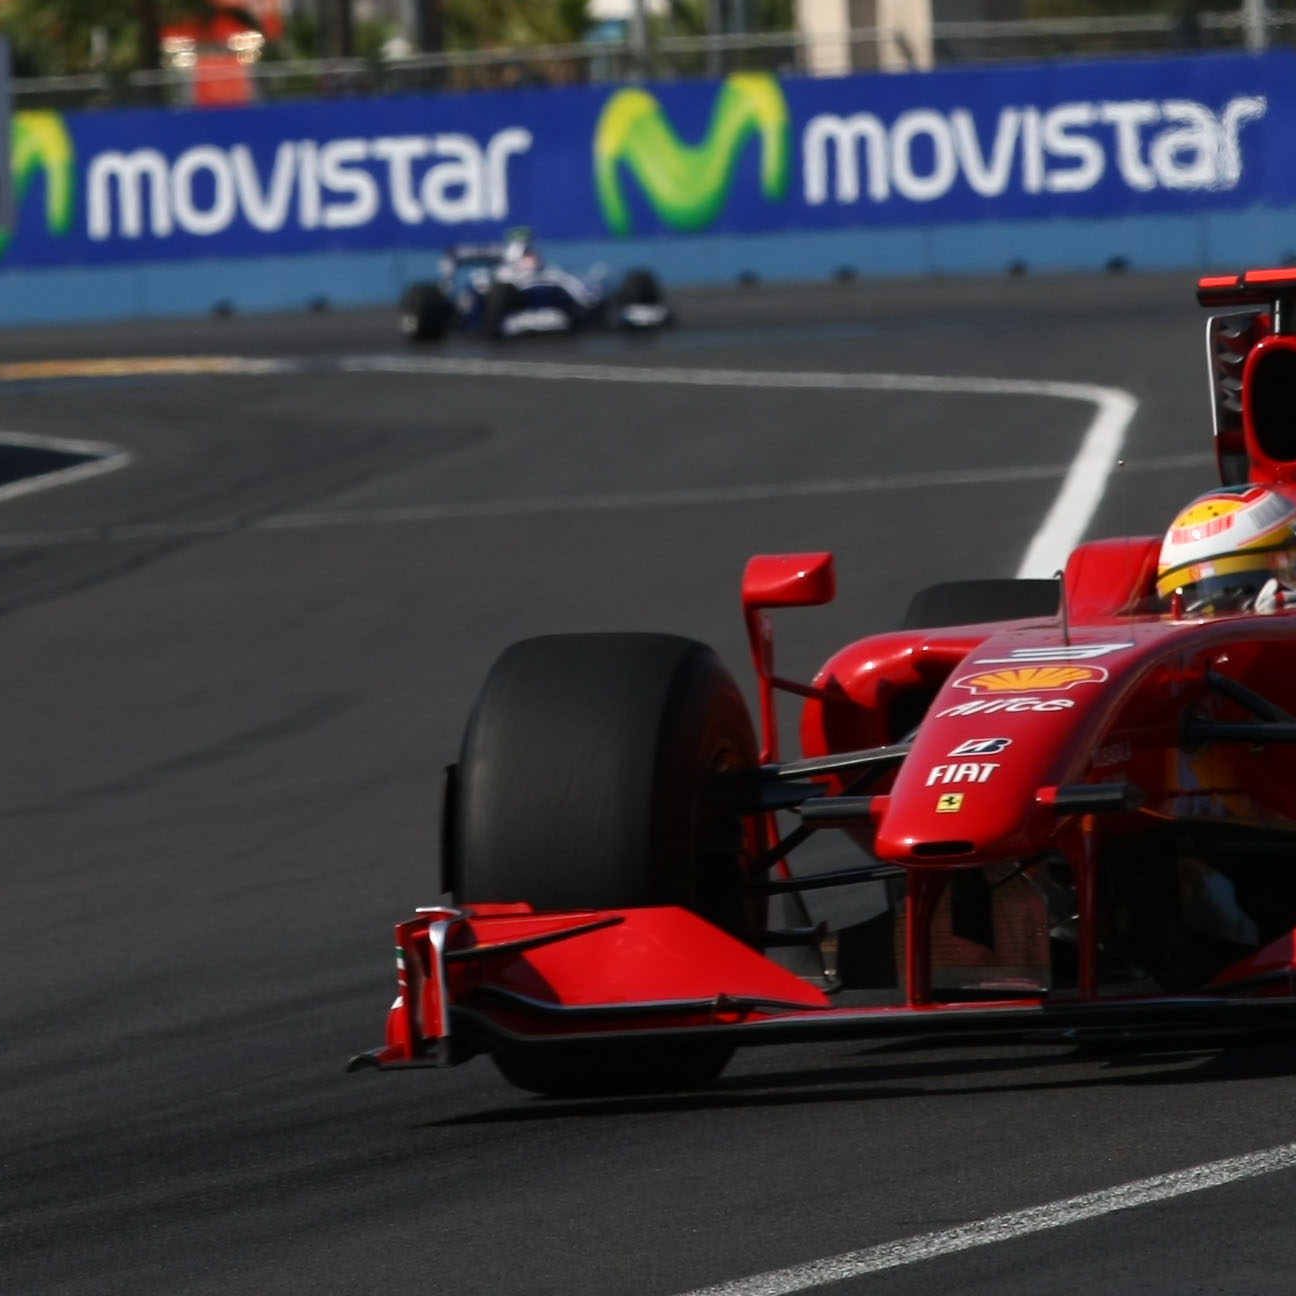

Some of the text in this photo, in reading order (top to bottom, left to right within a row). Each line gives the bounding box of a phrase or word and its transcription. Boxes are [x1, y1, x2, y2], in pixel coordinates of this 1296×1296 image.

[88, 130, 531, 239] movistar
[804, 97, 1266, 205] movistar
[925, 762, 1000, 787] FIAT
